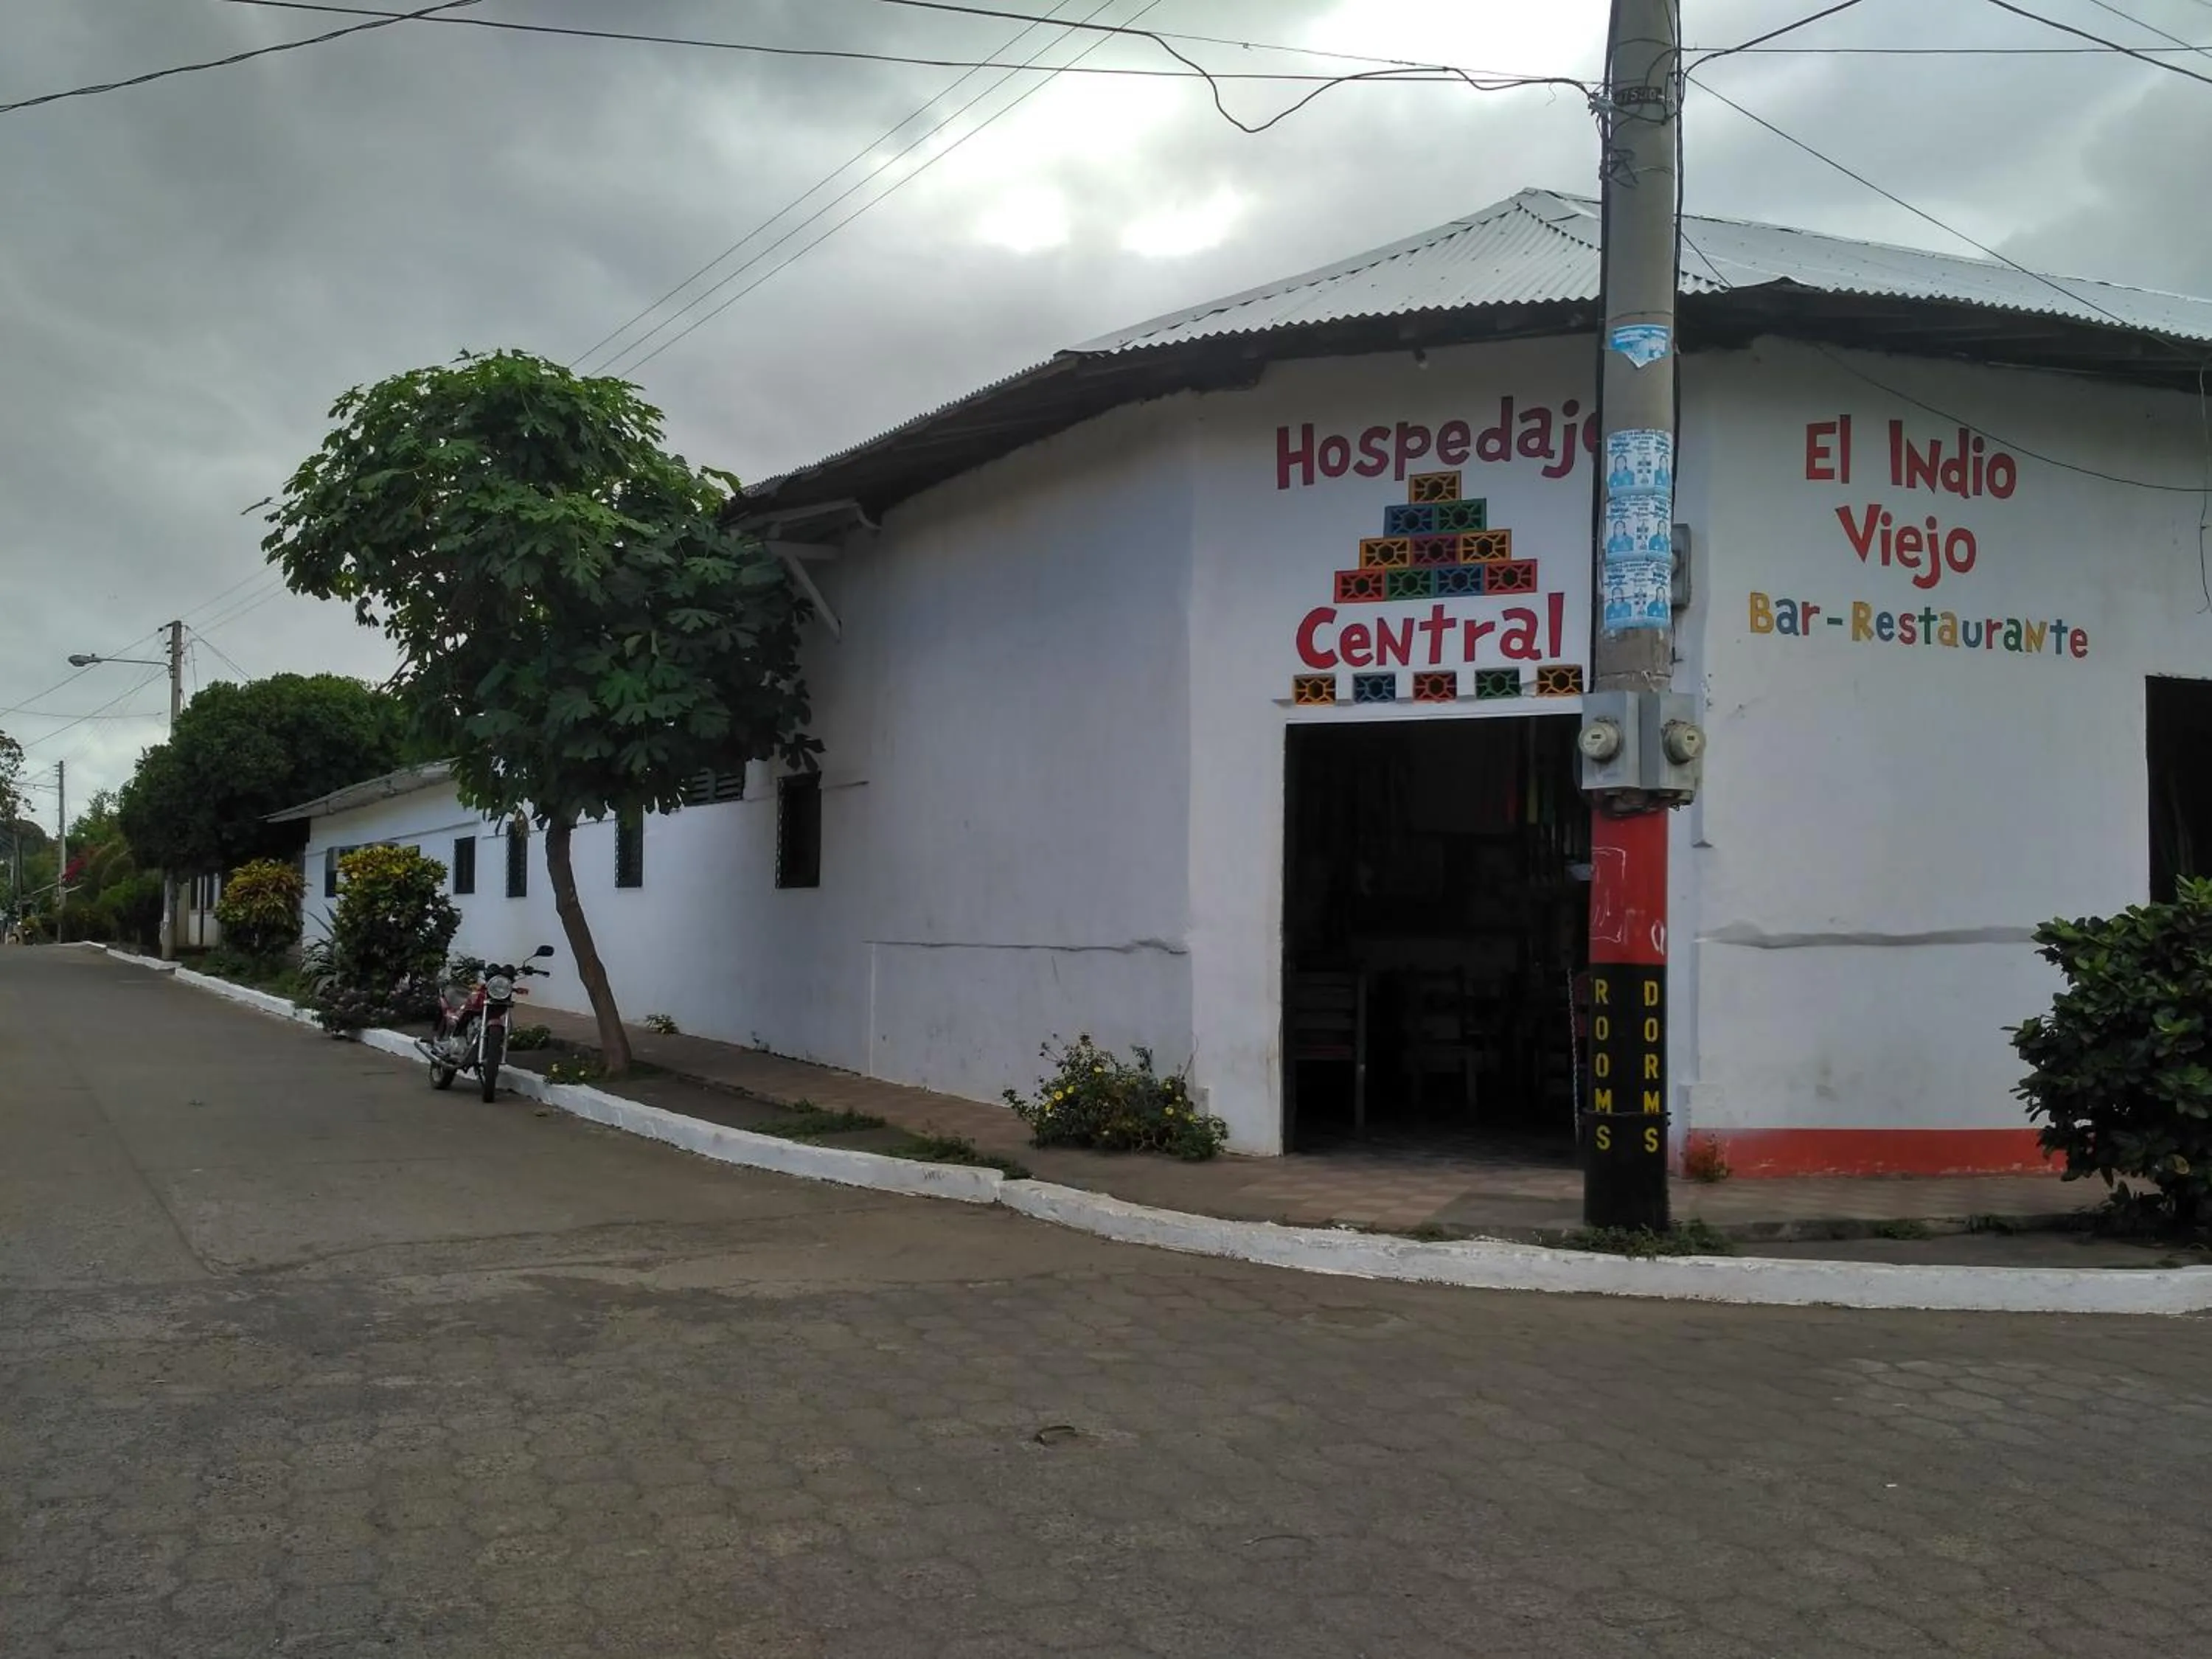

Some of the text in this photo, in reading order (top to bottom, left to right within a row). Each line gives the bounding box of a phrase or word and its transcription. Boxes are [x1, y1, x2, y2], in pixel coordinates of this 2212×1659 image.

[1806, 414, 1851, 484] El
[1835, 504, 1976, 589] Viejo
[1595, 978, 1613, 1150] ROOMS
[1644, 980, 1659, 1152] DORMS
